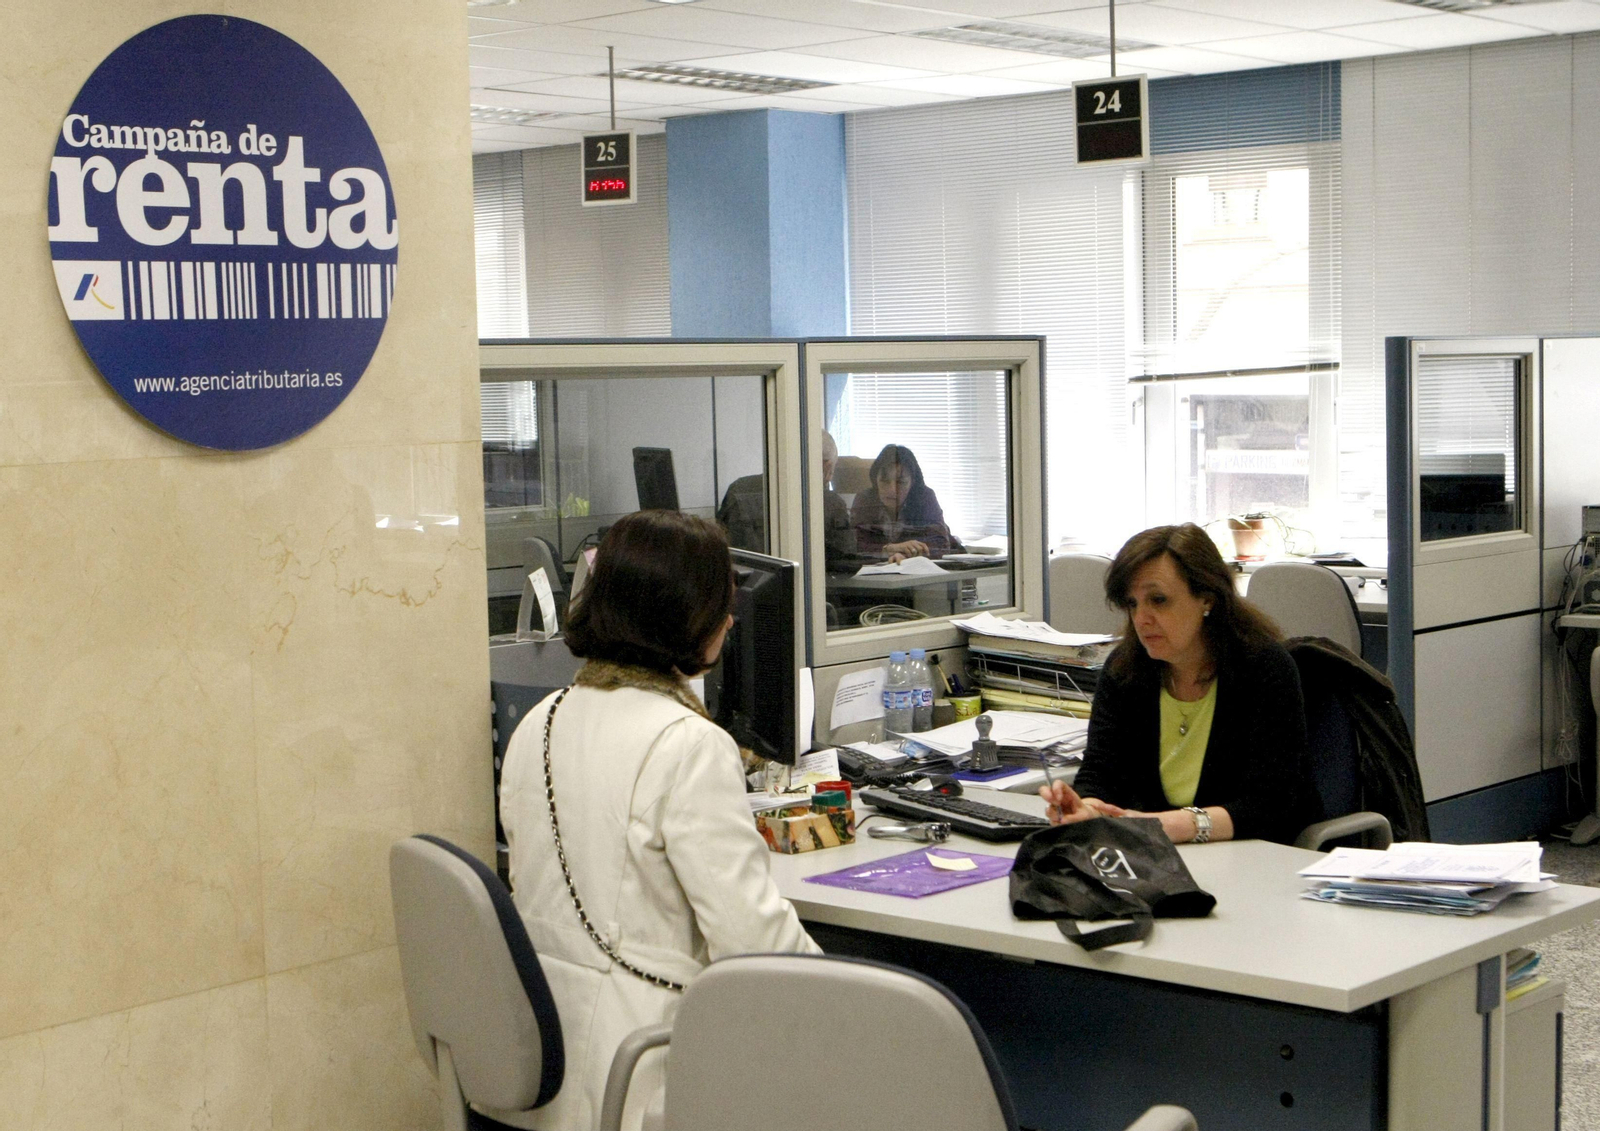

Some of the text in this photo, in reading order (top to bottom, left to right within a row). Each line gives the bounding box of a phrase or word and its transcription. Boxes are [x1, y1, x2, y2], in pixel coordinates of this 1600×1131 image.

[1093, 89, 1122, 115] 24
[62, 113, 278, 159] Campaña de
[596, 141, 617, 162] 25
[48, 135, 398, 250] renta
[134, 368, 343, 396] www.agenciatributaria.es
[1225, 455, 1278, 470] PARKING
